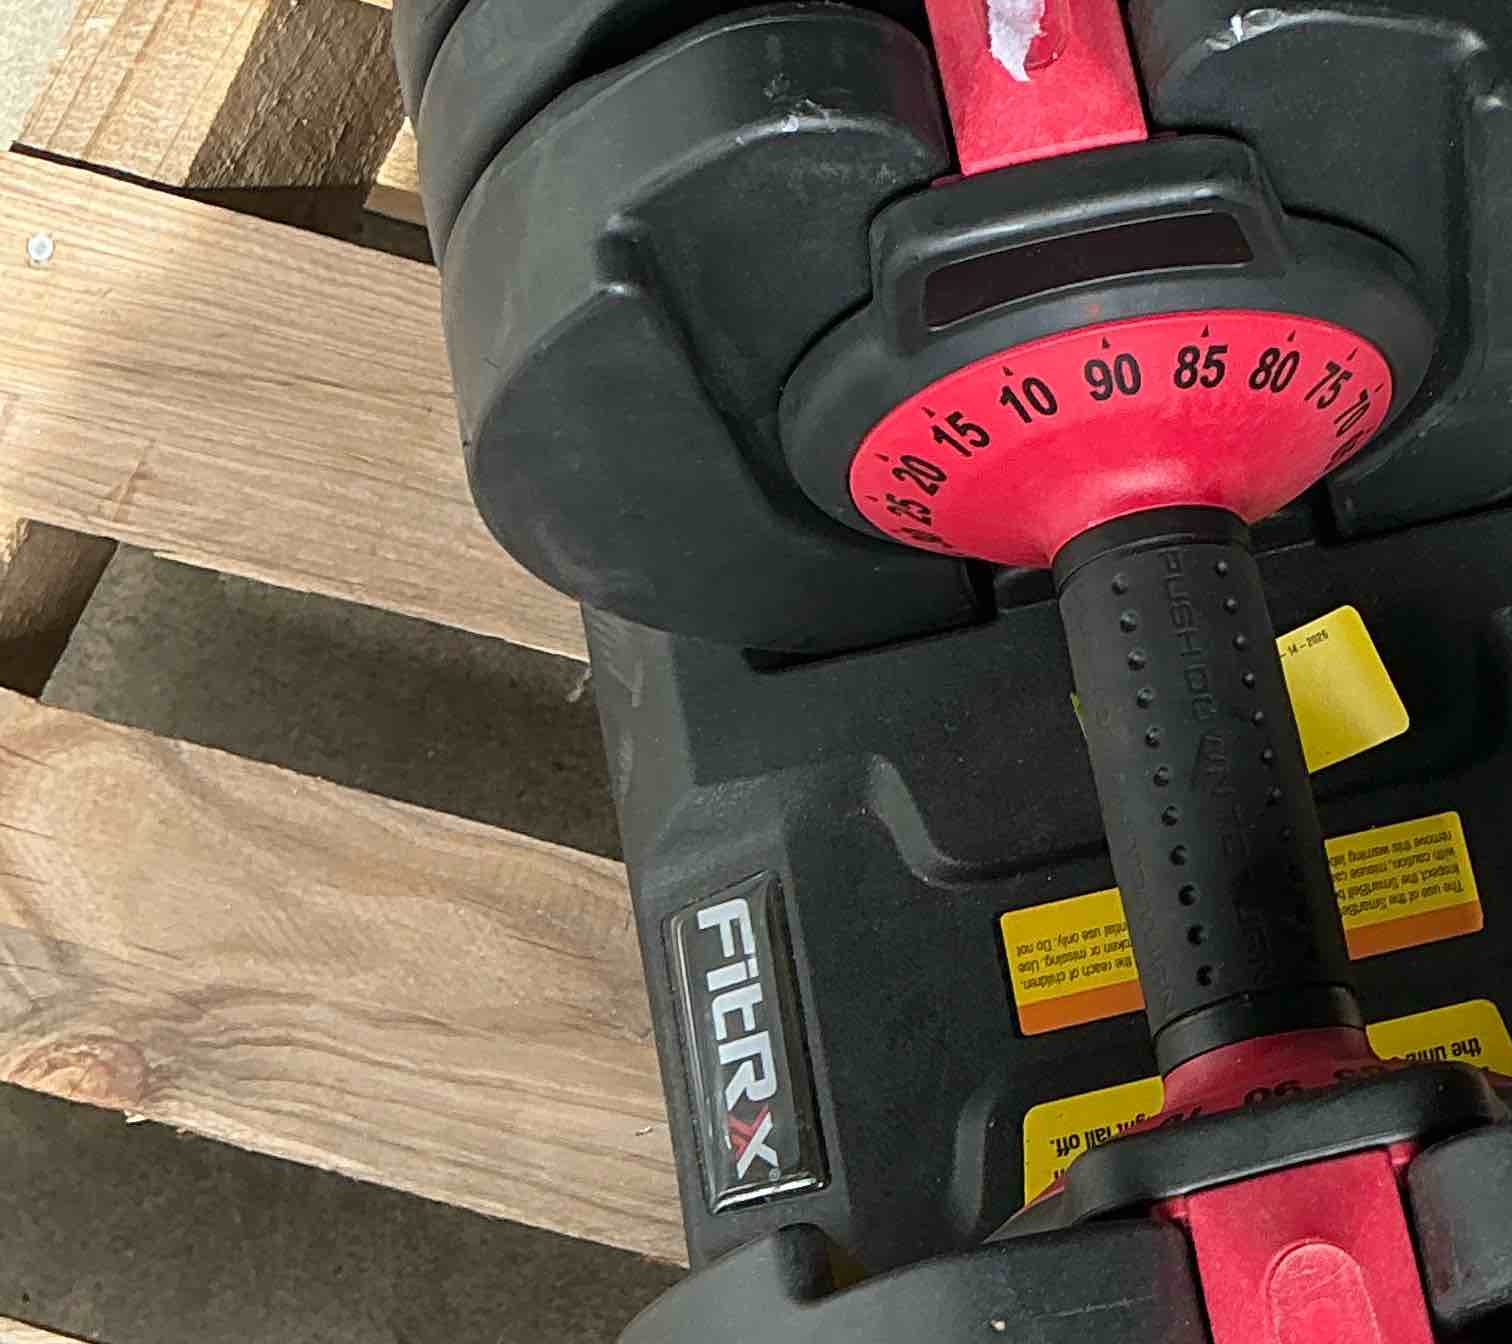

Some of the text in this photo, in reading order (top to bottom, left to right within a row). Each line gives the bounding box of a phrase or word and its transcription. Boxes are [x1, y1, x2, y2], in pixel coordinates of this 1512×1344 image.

[891, 454, 947, 496] 20
[931, 411, 991, 458] 15
[999, 376, 1058, 423] 10
[1084, 352, 1142, 401] 90
[1173, 344, 1229, 388] 85
[1249, 347, 1300, 393] 80
[1304, 360, 1353, 409] 75
[1333, 388, 1372, 438] 70
[1443, 879, 1464, 893] The
[1081, 927, 1102, 941] use
[1036, 939, 1052, 952] Do
[1017, 959, 1040, 973] Use
[1451, 1036, 1482, 1057] the
[1050, 1133, 1081, 1156] off.
